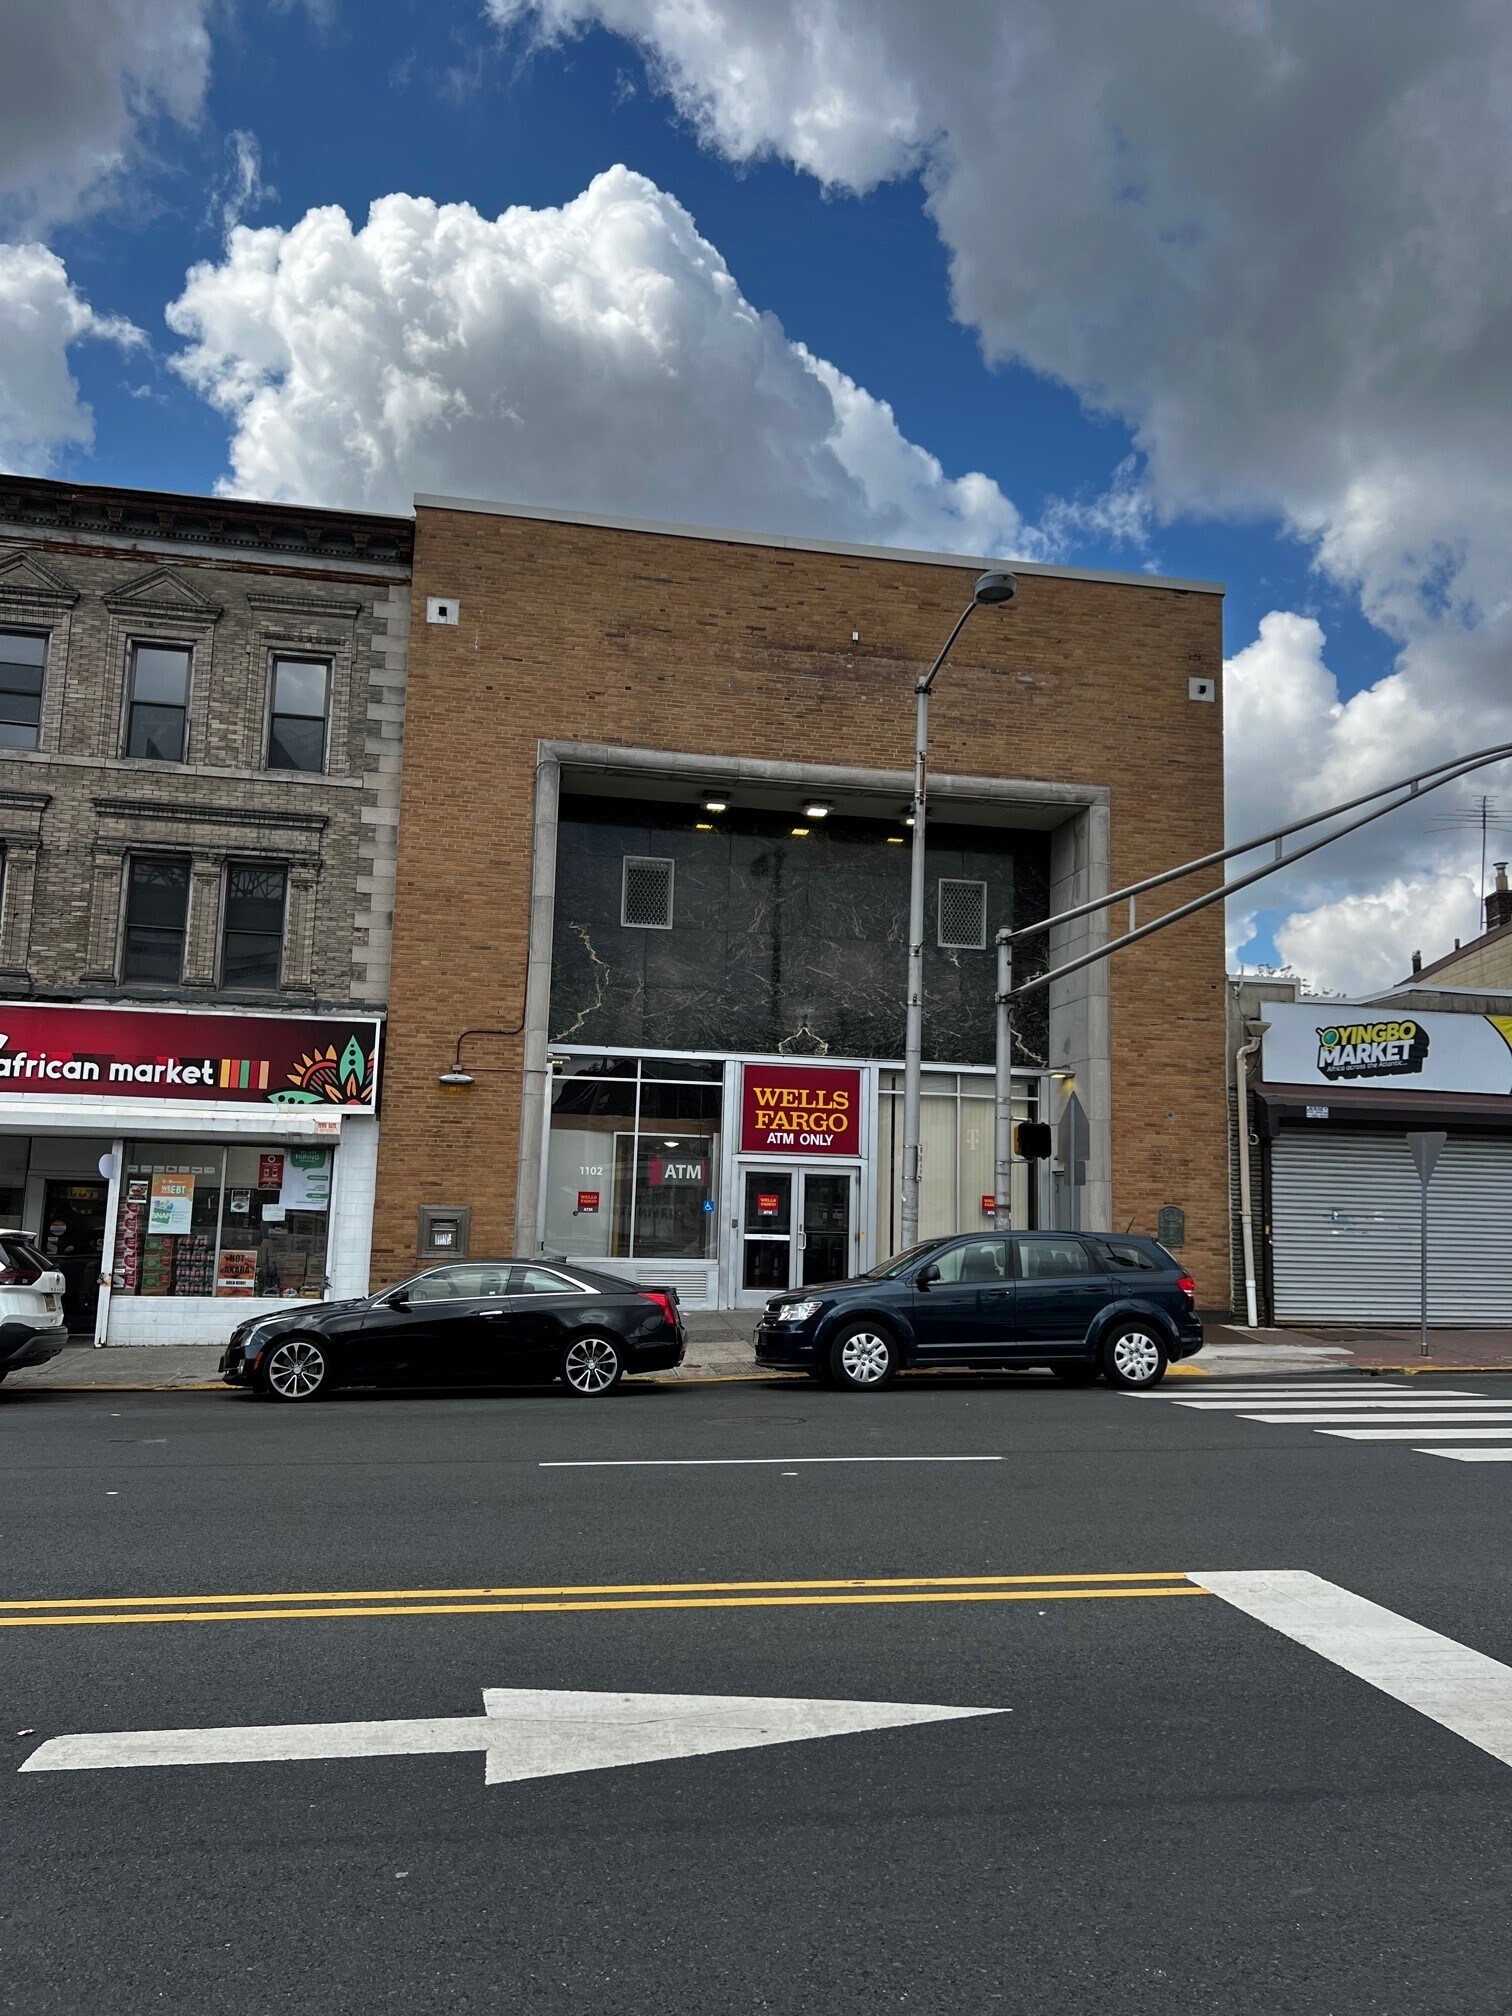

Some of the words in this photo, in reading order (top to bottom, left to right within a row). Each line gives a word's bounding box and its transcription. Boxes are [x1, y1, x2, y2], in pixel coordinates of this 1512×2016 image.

[1319, 1039, 1415, 1067] MARKET
[109, 1058, 214, 1085] market
[1346, 1063, 1366, 1071] across
[1367, 1061, 1378, 1069] the
[753, 1087, 849, 1110] WELLS
[755, 1110, 848, 1132] FARGO
[767, 1132, 794, 1145] ATM
[799, 1133, 834, 1146] ONLY
[580, 1166, 603, 1176] 1102
[664, 1164, 702, 1180] ATM
[171, 1185, 186, 1194] EBT
[152, 1211, 170, 1219] SNAP
[229, 1254, 246, 1263] HOT
[224, 1265, 250, 1275] AKARA
